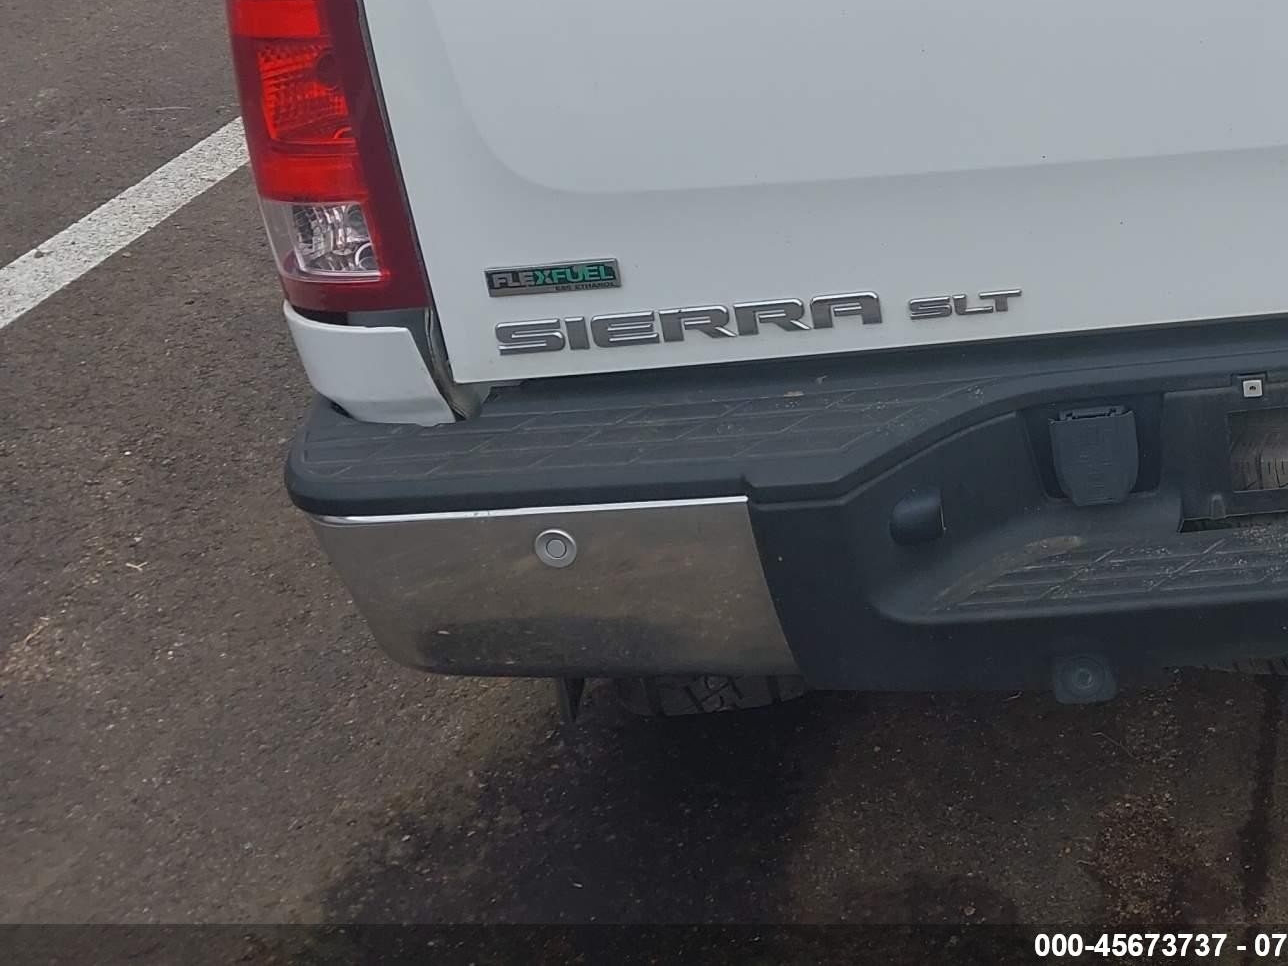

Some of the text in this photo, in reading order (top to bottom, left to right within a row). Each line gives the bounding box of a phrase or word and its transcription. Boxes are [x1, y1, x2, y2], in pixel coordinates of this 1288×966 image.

[491, 265, 615, 289] FLEXFUEL
[495, 288, 1022, 356] SIERRA SLT
